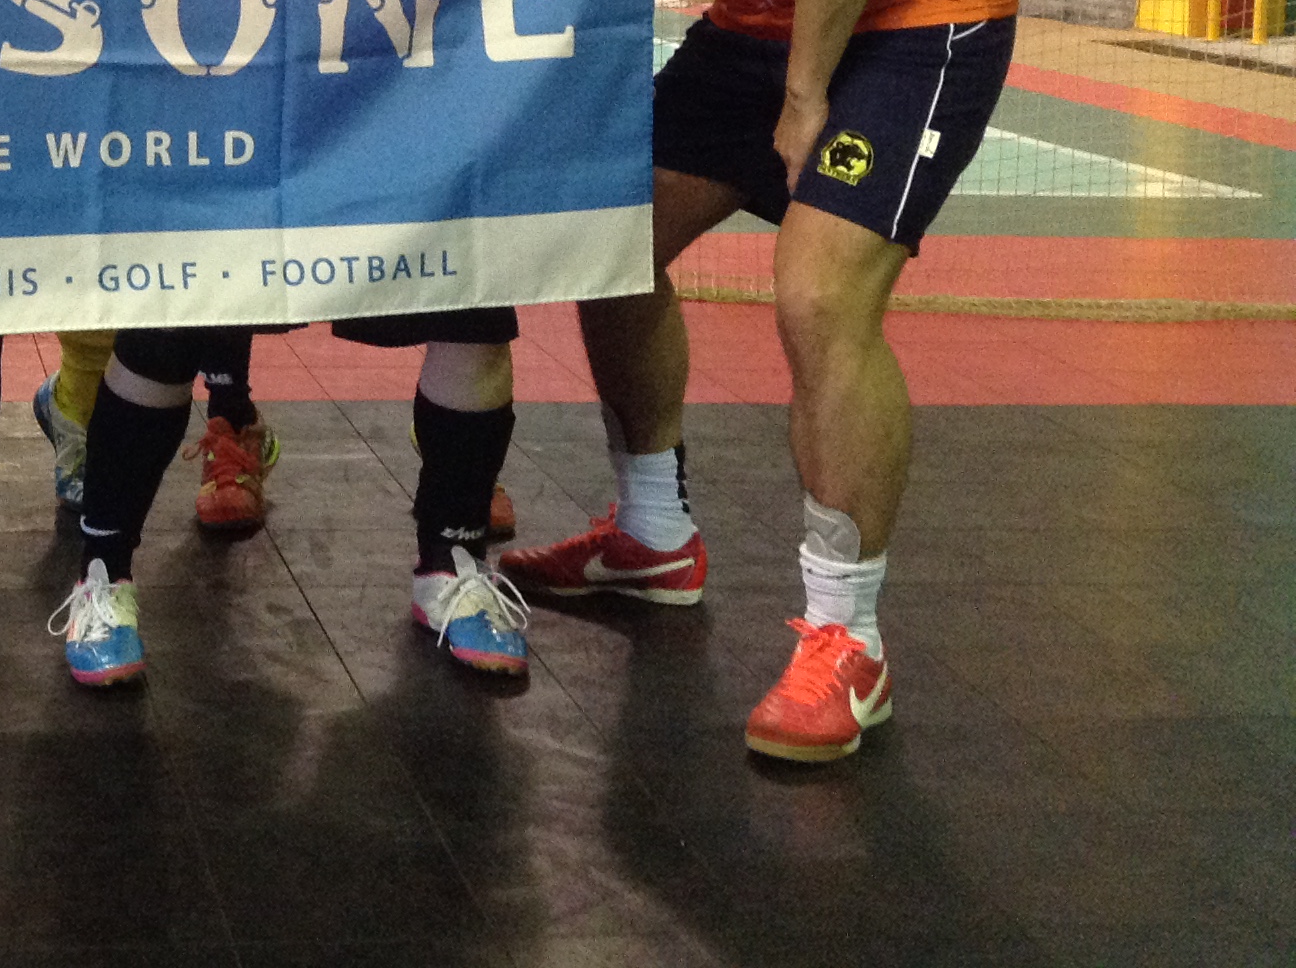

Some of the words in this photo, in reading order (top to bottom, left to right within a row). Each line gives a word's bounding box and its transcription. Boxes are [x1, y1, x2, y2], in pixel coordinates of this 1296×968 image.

[44, 129, 256, 169] WORLD
[97, 262, 198, 292] GOLF
[261, 249, 458, 288] FOOTBALL
